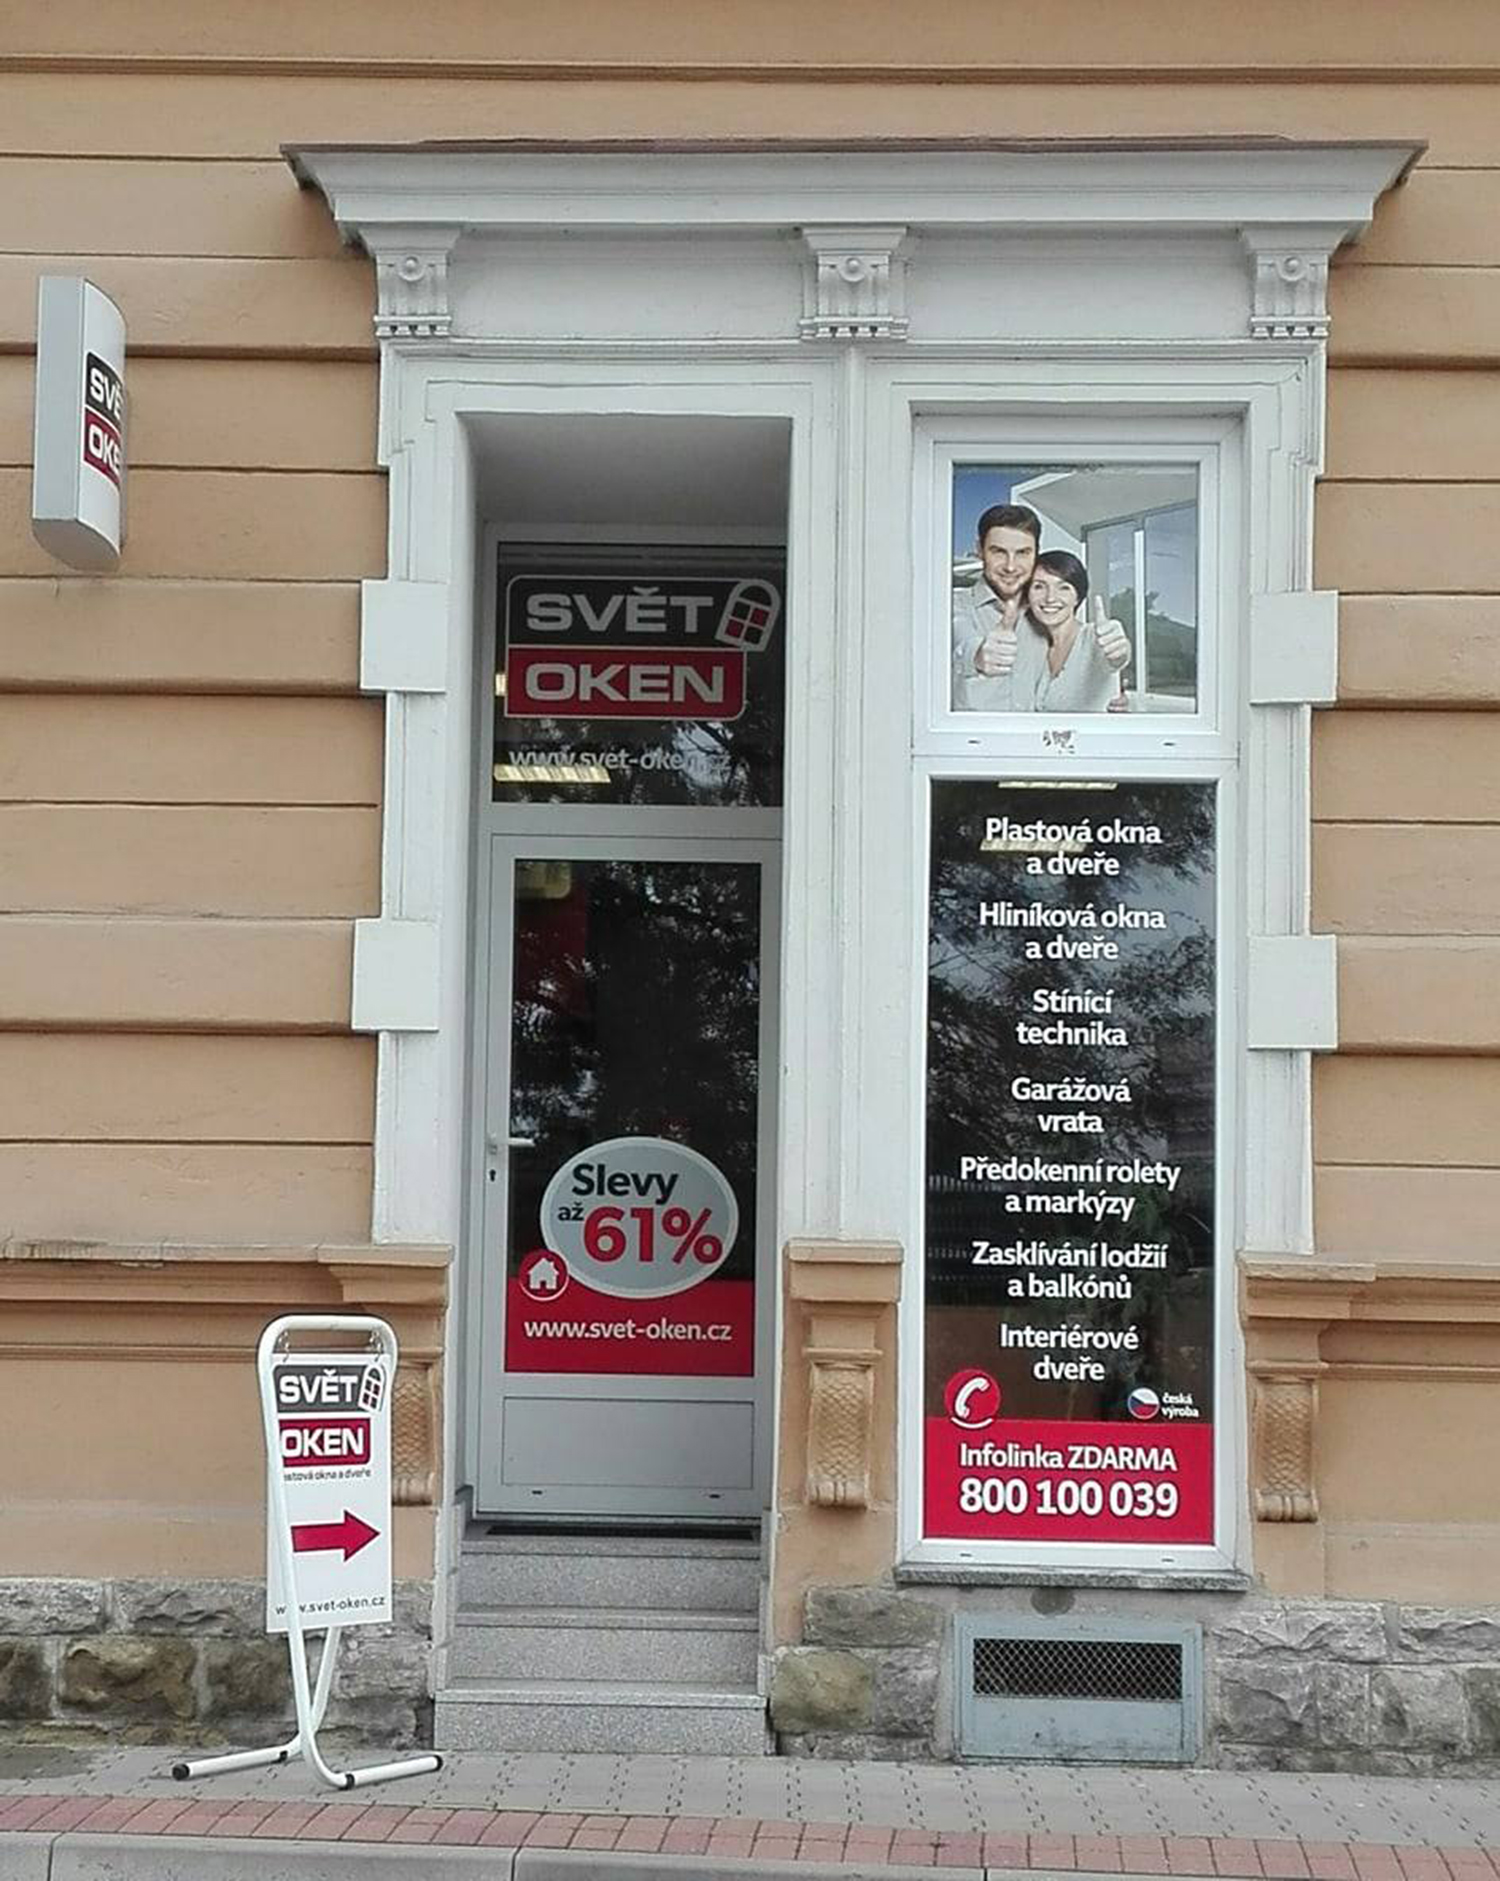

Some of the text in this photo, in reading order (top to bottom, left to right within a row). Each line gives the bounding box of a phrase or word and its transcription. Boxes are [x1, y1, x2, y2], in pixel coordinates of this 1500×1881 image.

[526, 586, 714, 633] SVĚT
[525, 663, 724, 702] OKEN
[985, 817, 1163, 844] Plastová okna
[1026, 850, 1119, 876] a dveře
[979, 902, 1166, 929] Hliníková okna
[1025, 935, 1119, 960] a dveře
[1033, 988, 1115, 1014] Stínící
[1016, 1021, 1128, 1046] technika
[1011, 1076, 1132, 1102] Garážová
[1038, 1110, 1104, 1133] vrata
[572, 1164, 679, 1205] Slevy
[960, 1156, 1181, 1191] Předokenní rolety
[1005, 1190, 1135, 1222] a markýzy
[558, 1202, 723, 1264] až 61%
[972, 1241, 1168, 1268] Zasklívání lodžií
[1007, 1273, 1132, 1299] a balkónů
[524, 1317, 732, 1341] www.svet-oken.cz
[1000, 1323, 1139, 1349] Interiérové
[1033, 1355, 1105, 1381] dveře
[279, 1369, 358, 1403] SVĚT
[280, 1427, 364, 1458] OKEN
[960, 1443, 1178, 1472] Infolinka ZDARMA
[959, 1477, 1178, 1517] 800 100 039
[275, 1597, 385, 1614] ww.svet-oken.cz
